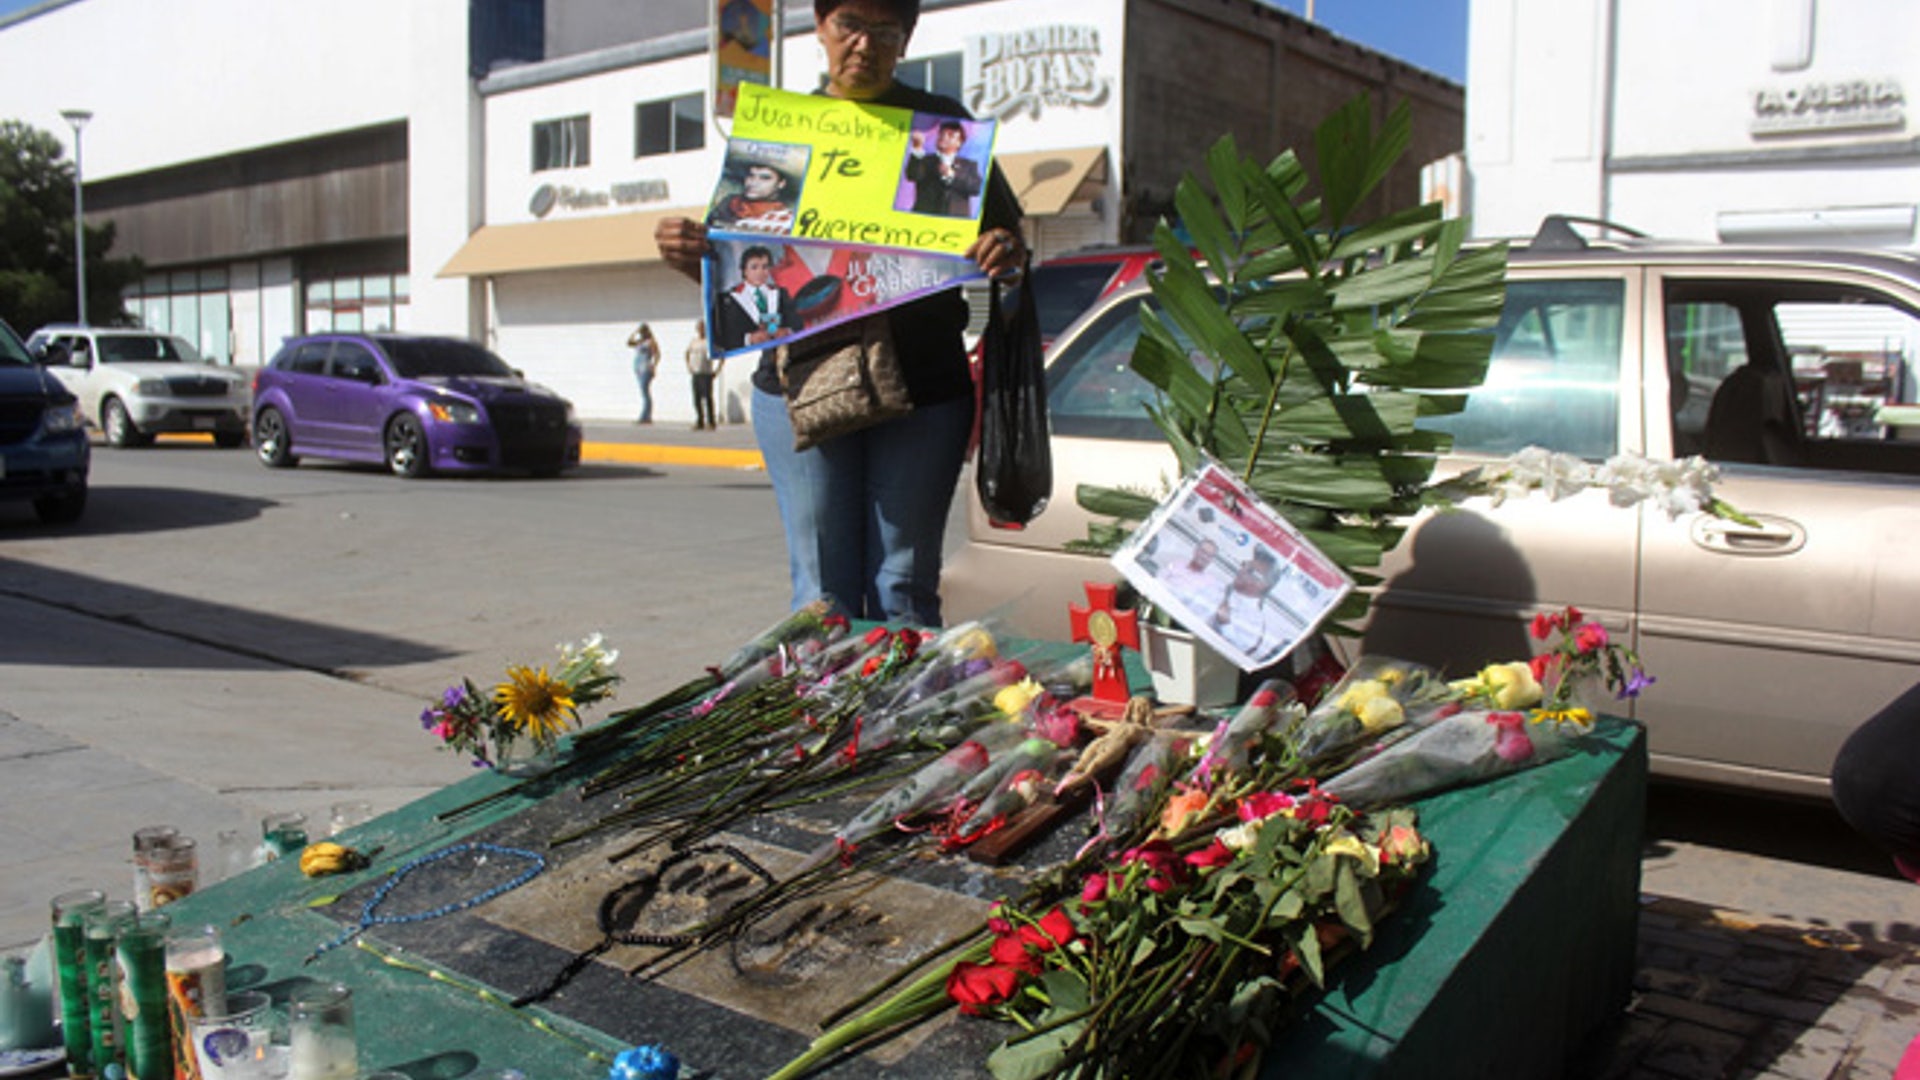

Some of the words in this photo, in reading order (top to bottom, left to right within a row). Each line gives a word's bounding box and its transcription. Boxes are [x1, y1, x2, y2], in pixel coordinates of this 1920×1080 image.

[963, 25, 1101, 88] PREMIER
[982, 51, 1099, 108] BOTAS
[742, 93, 813, 129] Juan
[817, 109, 906, 142] Gabriel
[846, 254, 901, 282] JUAN
[852, 268, 941, 297] GABRIEL
